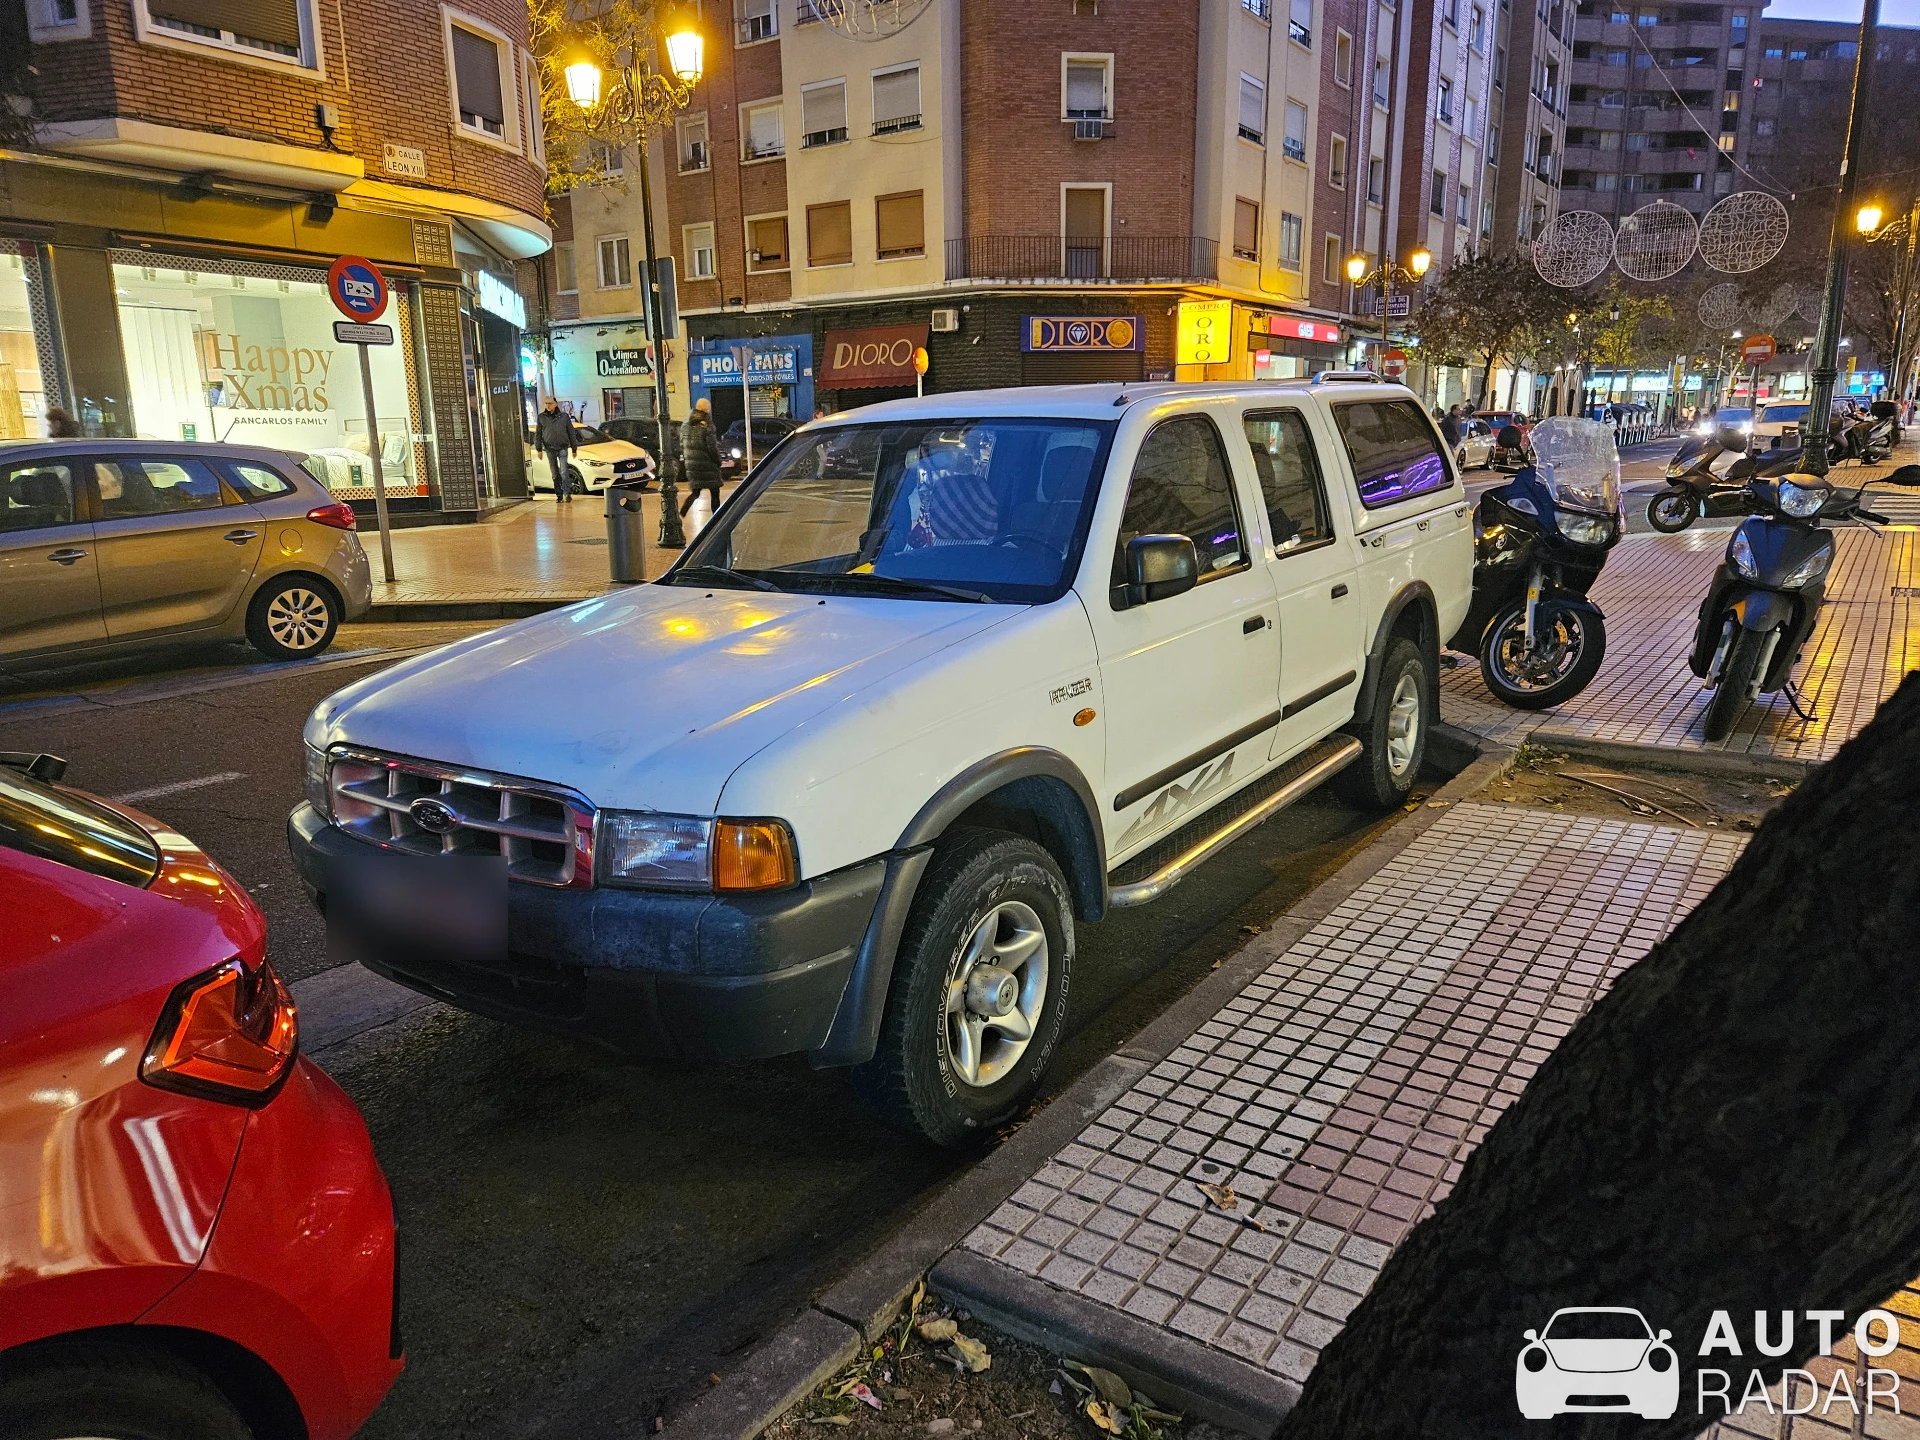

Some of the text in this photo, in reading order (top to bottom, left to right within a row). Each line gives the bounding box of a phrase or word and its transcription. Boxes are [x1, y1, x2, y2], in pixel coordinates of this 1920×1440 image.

[398, 150, 421, 161] CALLE
[387, 160, 424, 176] LEON XIII
[1181, 302, 1230, 311] COMPRO
[1032, 318, 1134, 349] DIORO
[1195, 316, 1213, 362] ORO
[208, 333, 334, 386] Happy
[702, 353, 793, 374] PHON FANS
[832, 338, 913, 370] DIORO
[599, 359, 649, 376] Ordenadores
[223, 374, 329, 412] Xmas
[235, 416, 328, 425] SANCARLOS FAMILY
[1048, 677, 1093, 705] RANGER
[420, 806, 442, 824] Ford
[1030, 953, 1071, 1082] COOPER
